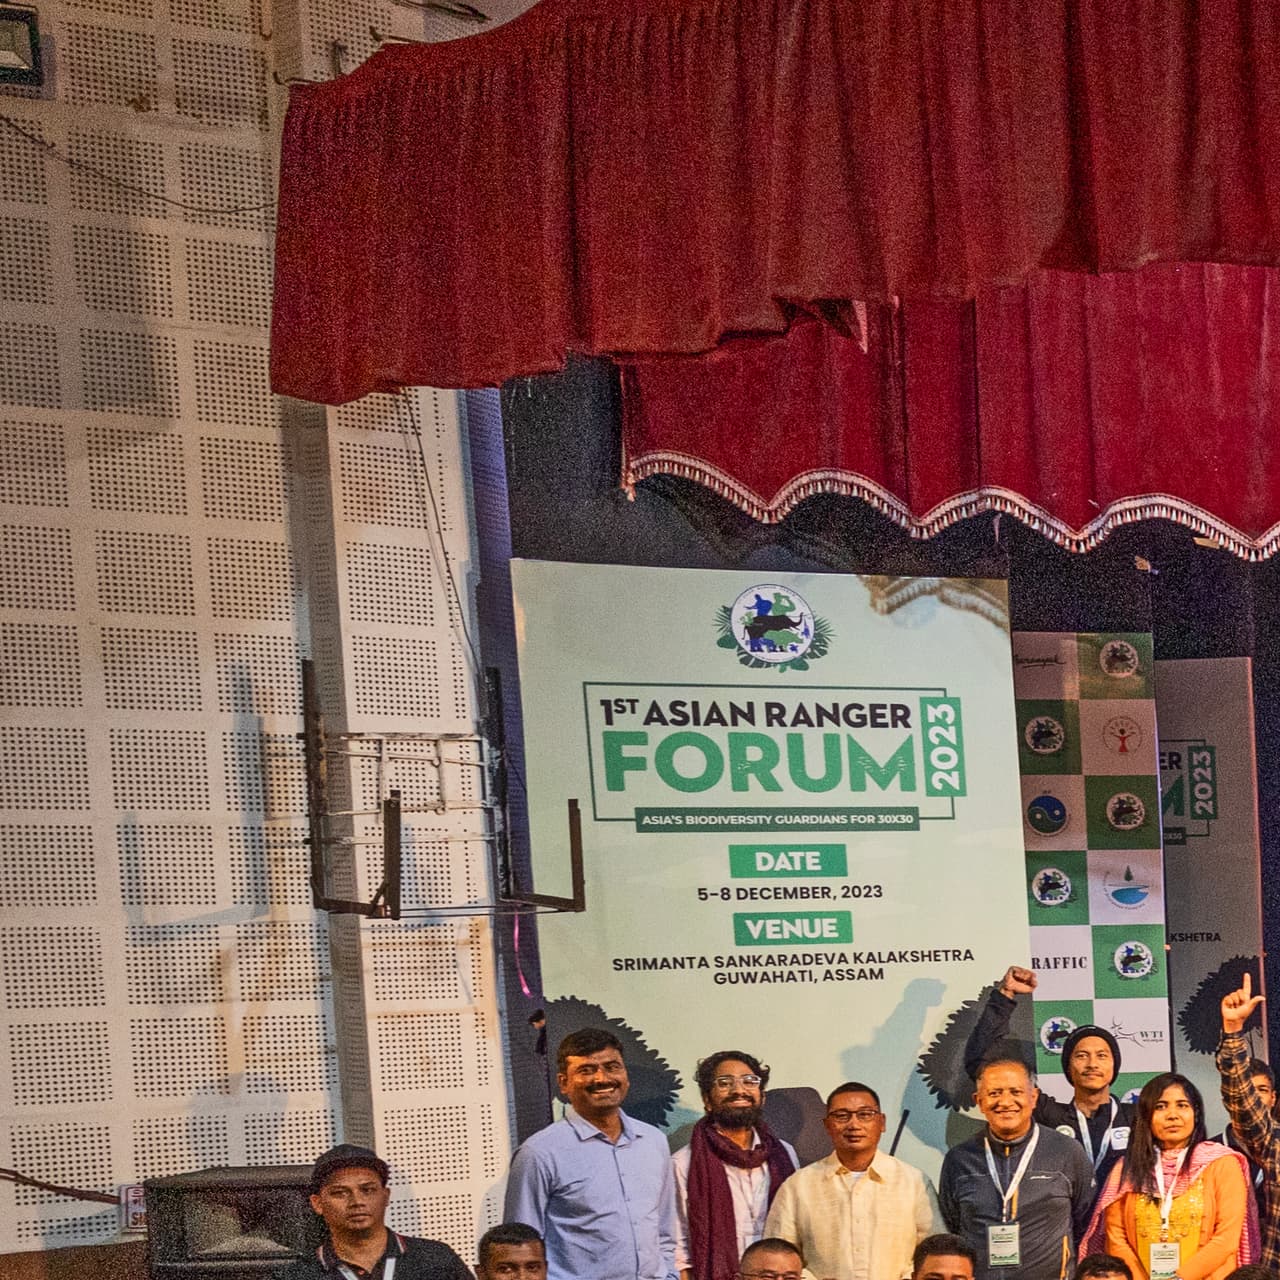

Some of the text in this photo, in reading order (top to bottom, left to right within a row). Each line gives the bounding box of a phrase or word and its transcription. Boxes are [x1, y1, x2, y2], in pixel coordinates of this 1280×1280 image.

[600, 698, 911, 729] 1ST ASIAN RANGER
[928, 703, 961, 791] 2023
[602, 730, 917, 793] FORUM
[1193, 751, 1214, 815] 2023
[642, 814, 914, 826] ASIA'S BIODIVERSITY GUARDIANS FOR 30X30
[755, 851, 821, 872] DATE
[736, 886, 836, 903] DECEMBER,
[841, 885, 883, 900] 2023
[745, 919, 839, 939] VENUE
[1169, 932, 1222, 943] KSHETRA
[613, 949, 975, 972] SRIMANTA SANKARADEVA KALAKSHETRA
[1031, 956, 1088, 970] RAFFIC
[713, 967, 885, 986] GUWAHATI, ASSAM
[1139, 1030, 1164, 1038] WTI
